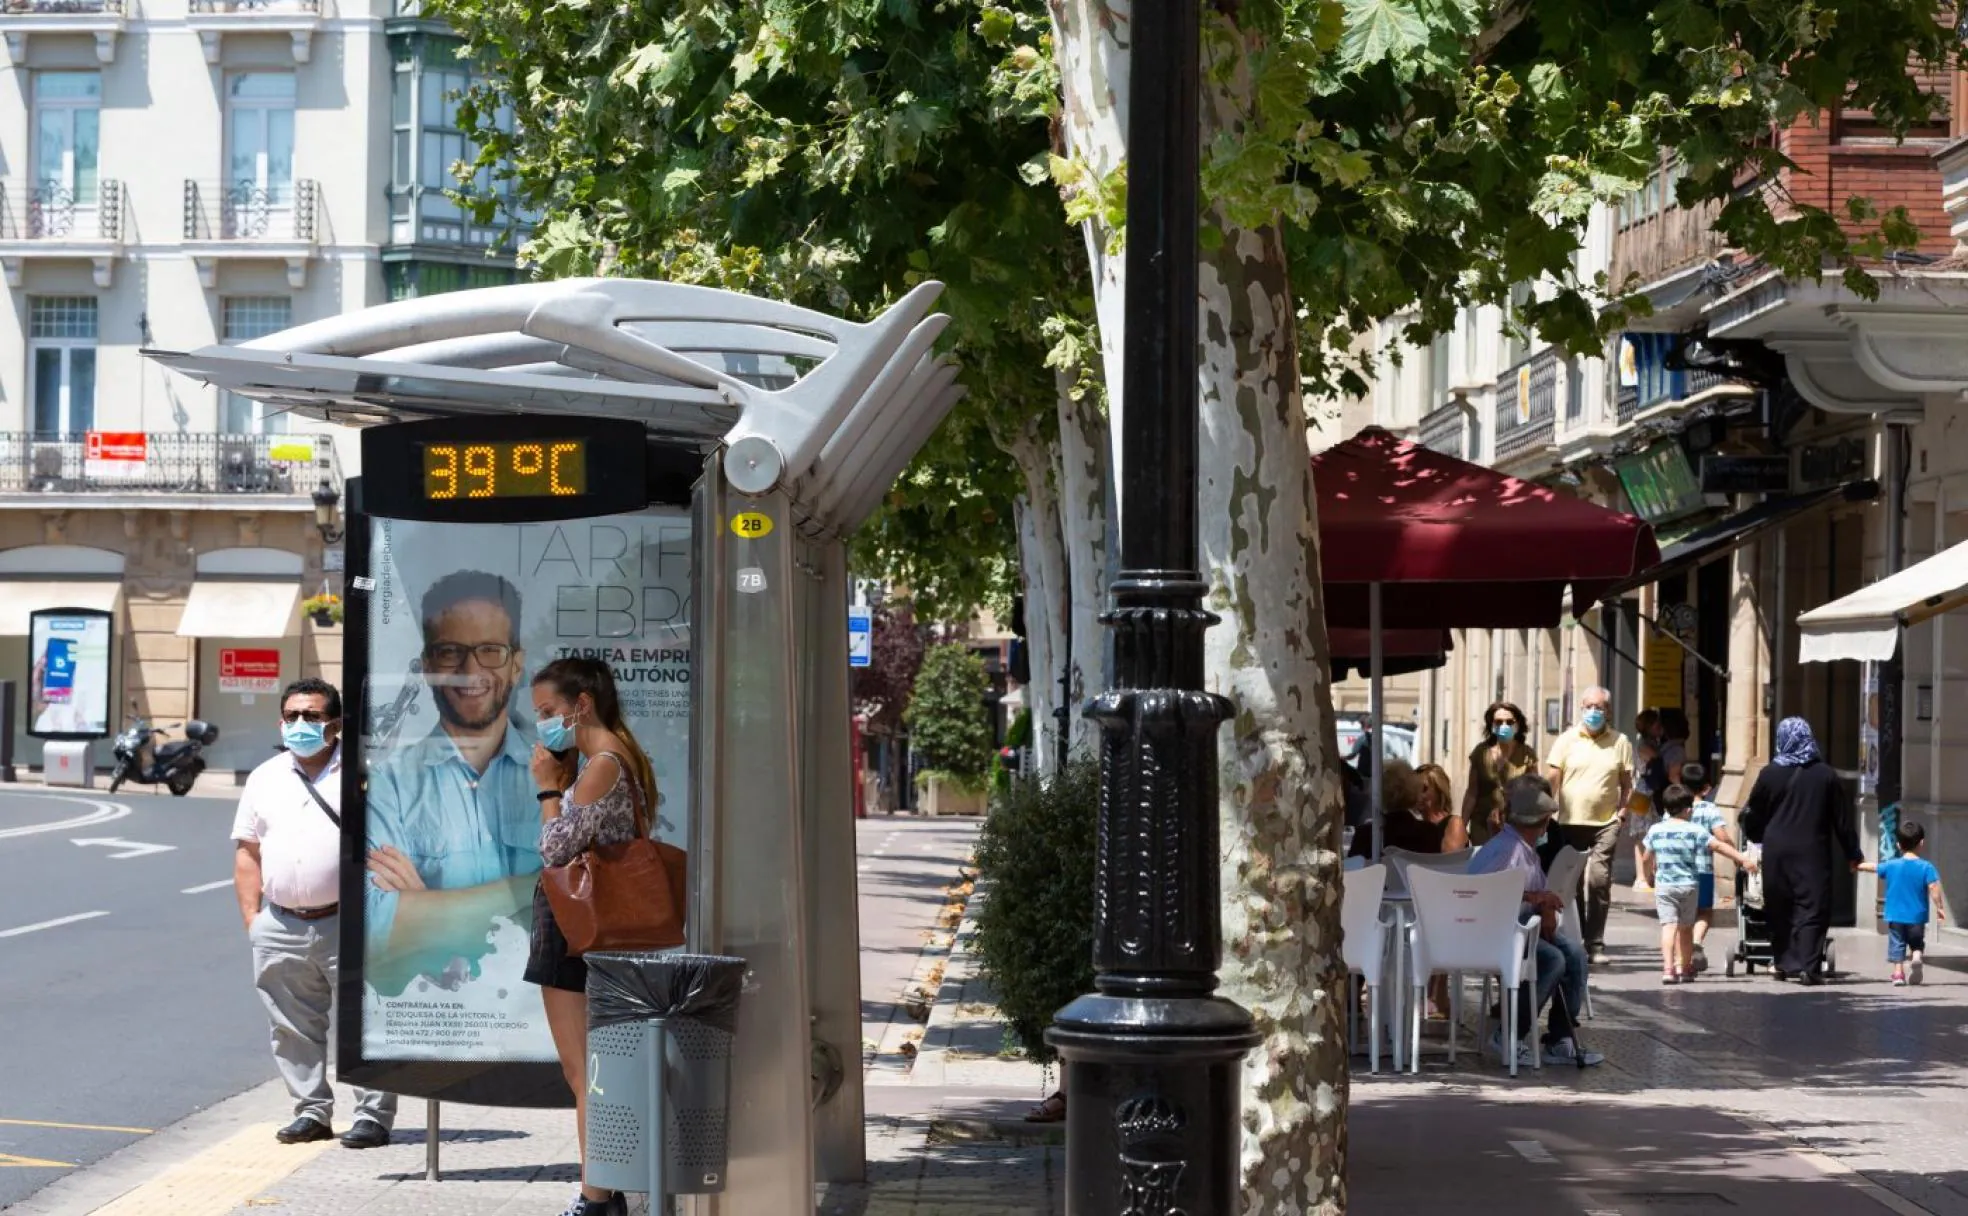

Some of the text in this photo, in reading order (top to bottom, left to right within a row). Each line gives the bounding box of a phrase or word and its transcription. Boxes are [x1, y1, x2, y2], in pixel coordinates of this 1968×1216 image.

[431, 445, 495, 499] 39
[503, 523, 691, 578] TARIF
[741, 519, 762, 531] 2B
[741, 574, 761, 587] 7B
[556, 585, 691, 640] EBR
